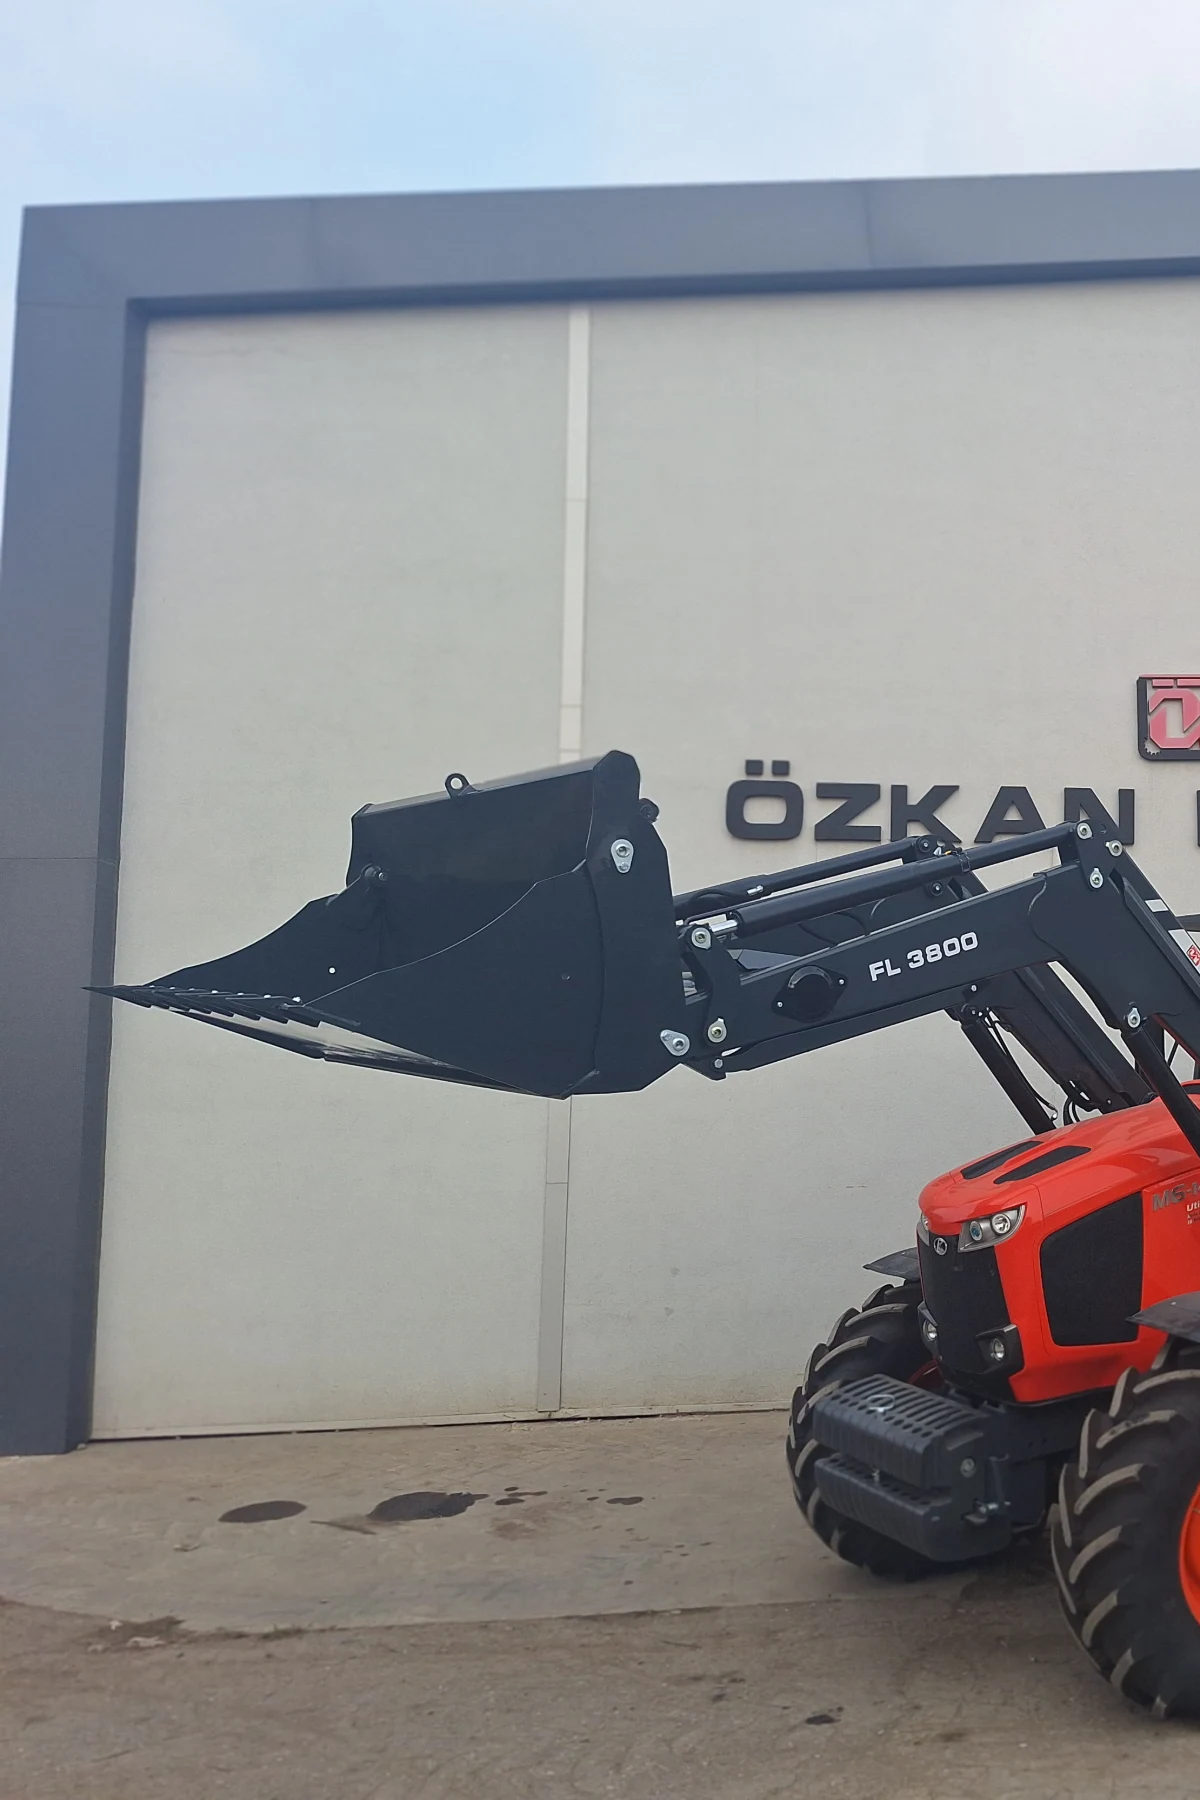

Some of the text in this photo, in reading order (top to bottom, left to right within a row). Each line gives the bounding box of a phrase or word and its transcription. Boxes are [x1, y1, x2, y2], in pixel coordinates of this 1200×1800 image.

[726, 760, 1135, 845] ÖZKAN
[868, 931, 979, 982] FL 3800
